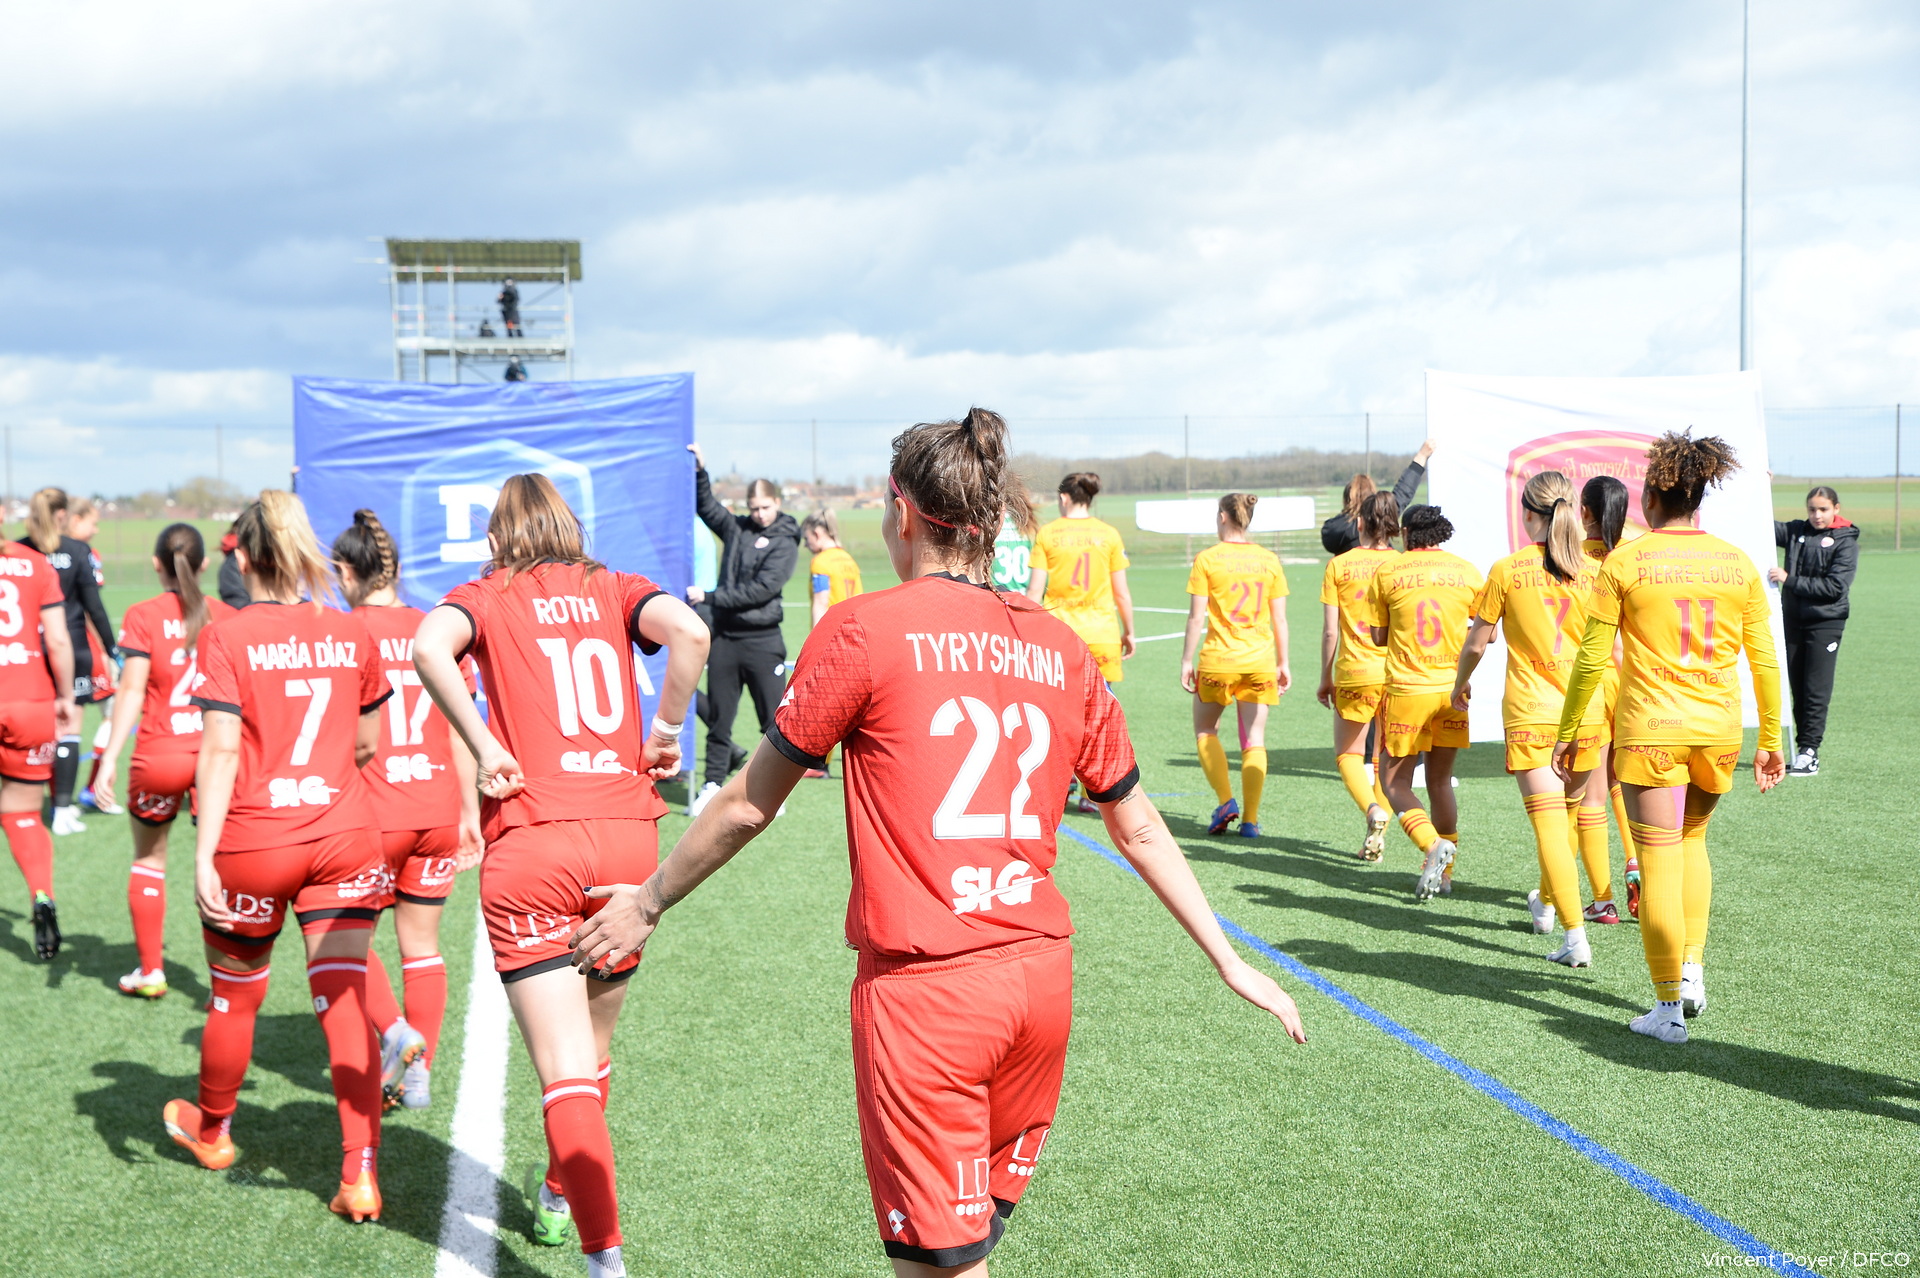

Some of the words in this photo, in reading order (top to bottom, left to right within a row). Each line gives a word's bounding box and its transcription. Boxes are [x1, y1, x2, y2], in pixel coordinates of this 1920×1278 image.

[994, 545, 1031, 584] 30
[1070, 552, 1090, 592] 4
[1226, 561, 1268, 574] CANON
[1391, 559, 1467, 573] JeanStation.com
[1635, 548, 1740, 562] JeanStation.com
[1393, 573, 1425, 591] MZE
[1432, 572, 1466, 588] ISSA
[1637, 565, 1745, 586] PIERRE-LOUIS
[532, 595, 601, 626] ROTH
[1229, 581, 1265, 623] 21
[1416, 598, 1442, 648] 6
[1543, 598, 1571, 655] 7
[1672, 597, 1716, 666] 11
[246, 635, 312, 671] MARÍA
[314, 634, 358, 669] DÍAZ
[905, 631, 1066, 691] TYRYSHKINA
[385, 669, 434, 746] 17
[536, 637, 625, 738] 10
[285, 677, 332, 766] 7
[385, 752, 435, 784] SIG
[930, 696, 1051, 840] 22
[267, 775, 335, 808] SIG
[950, 859, 1038, 916] SIG
